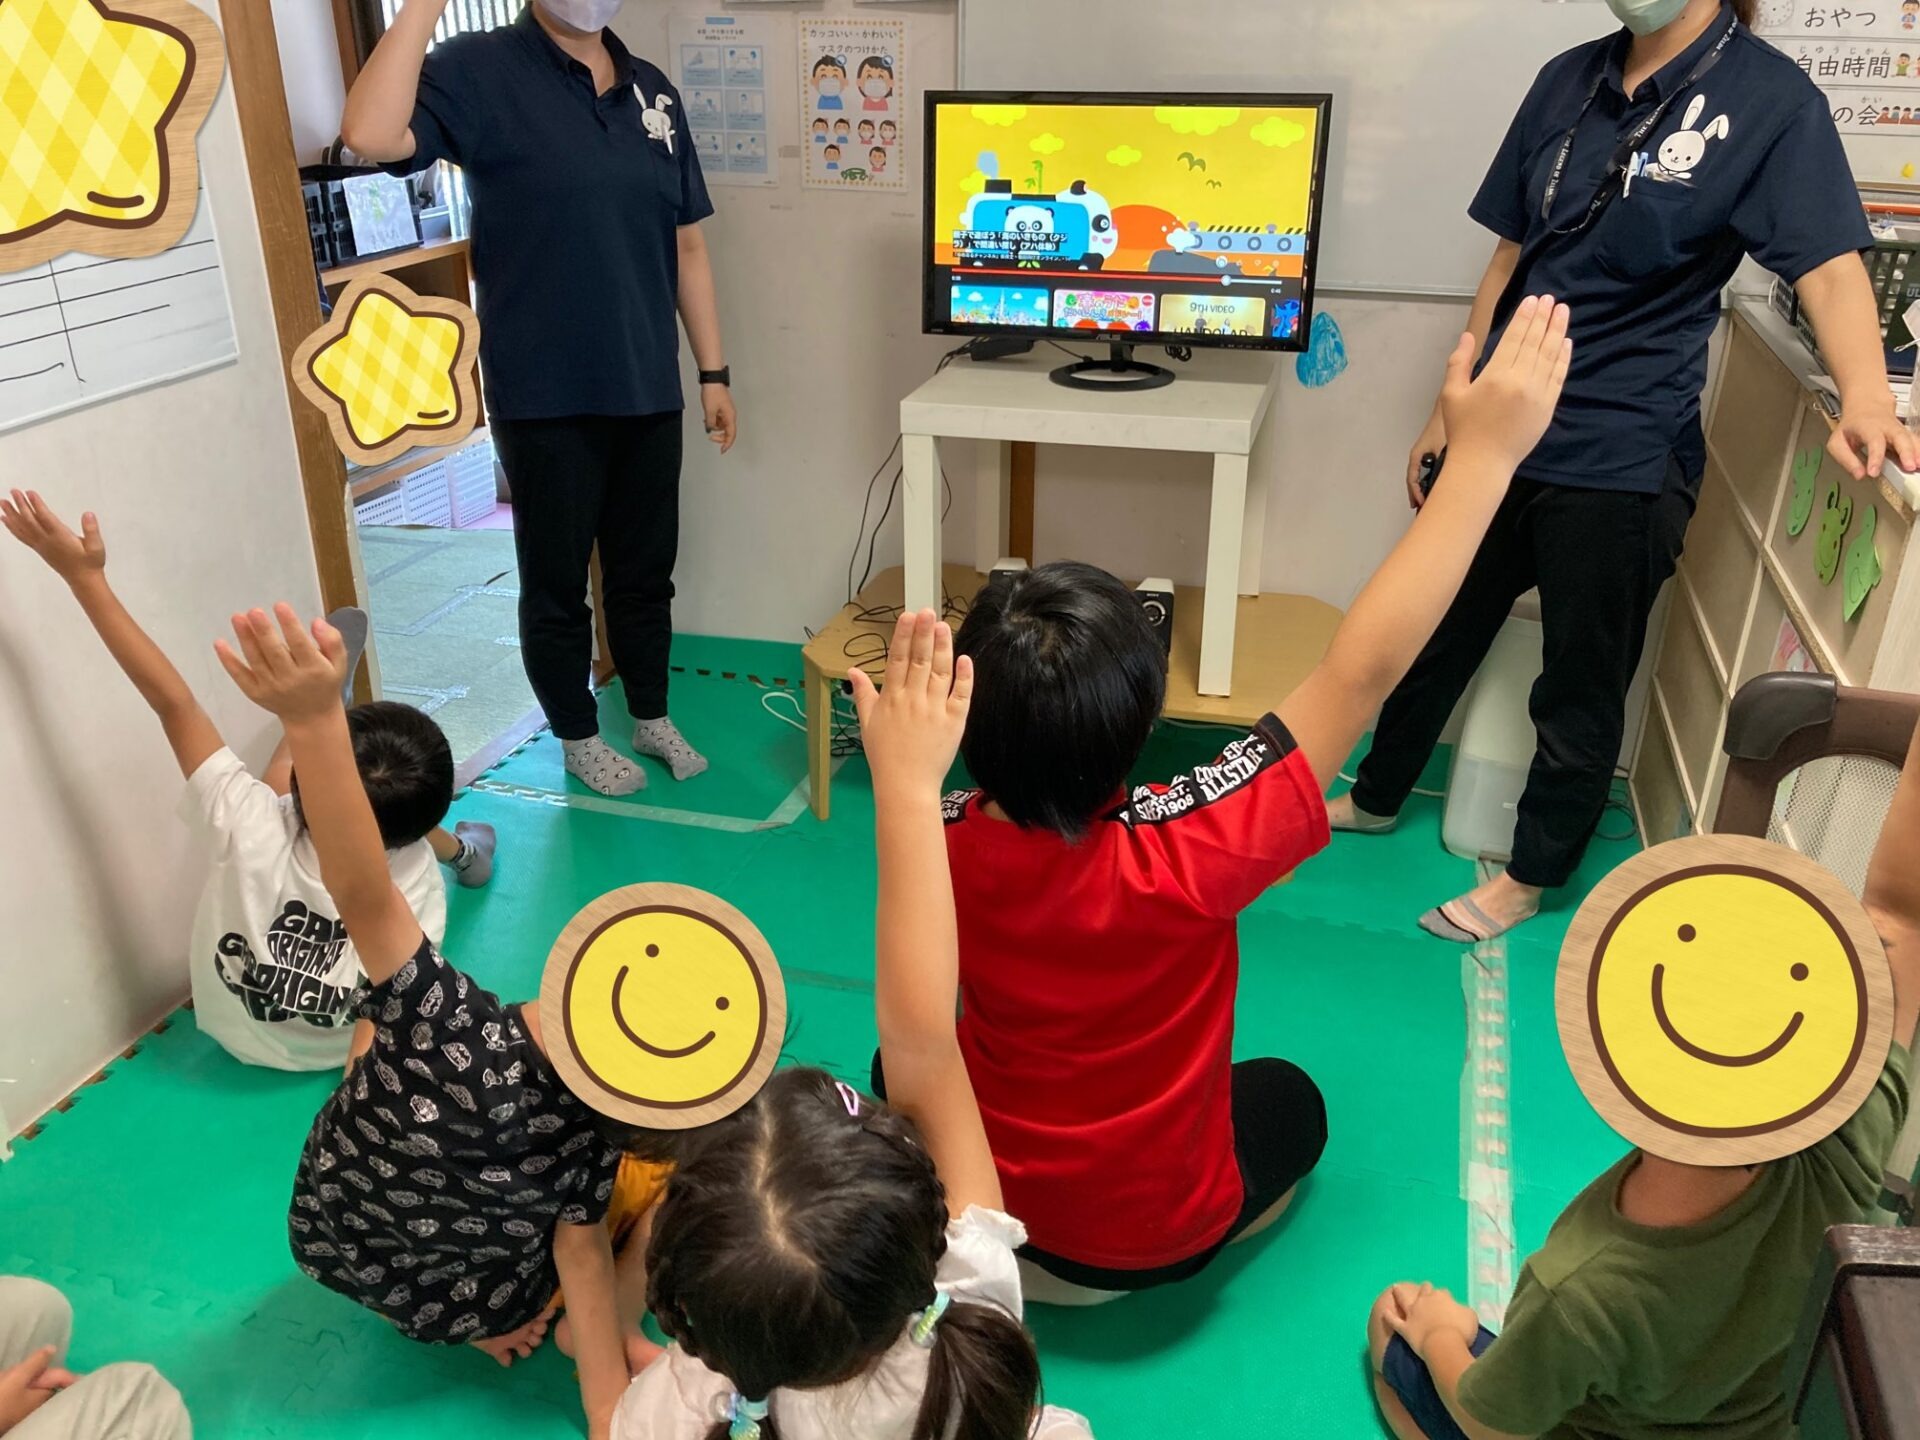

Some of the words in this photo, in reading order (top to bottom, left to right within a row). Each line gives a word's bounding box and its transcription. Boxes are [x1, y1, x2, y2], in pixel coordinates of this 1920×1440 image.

[1804, 7, 1876, 28] おやつ
[818, 44, 888, 55] マスクのつけかた
[1797, 55, 1891, 79] 自由時間
[1833, 104, 1880, 126] の会
[1190, 302, 1208, 312] 9TH
[1210, 305, 1236, 314] VIDEO
[255, 963, 352, 1016] ORIGIN
